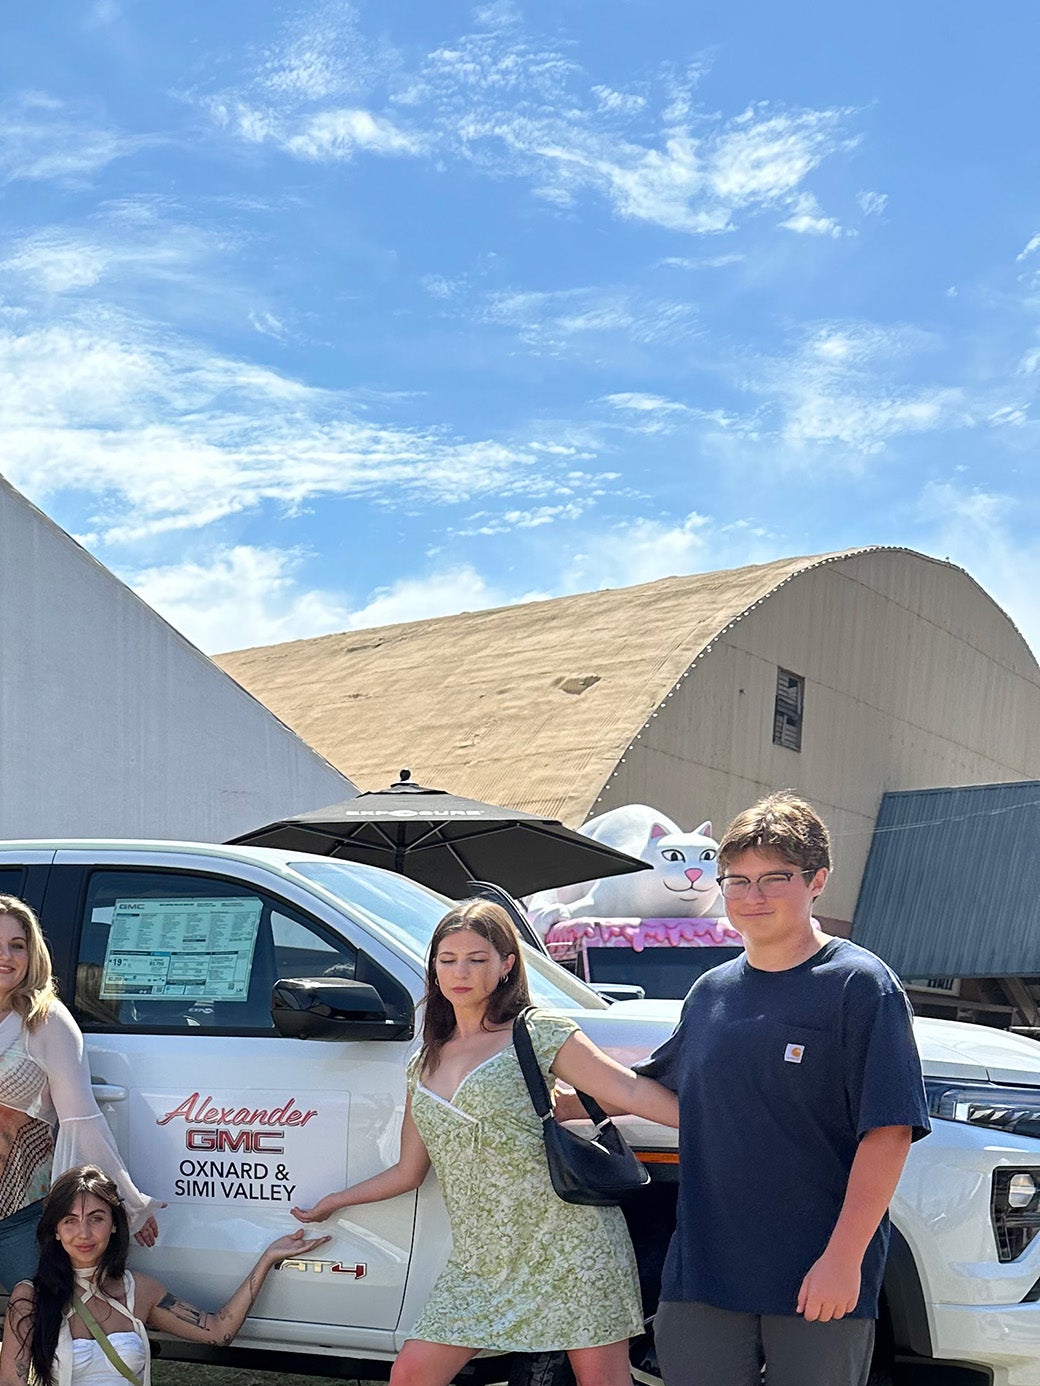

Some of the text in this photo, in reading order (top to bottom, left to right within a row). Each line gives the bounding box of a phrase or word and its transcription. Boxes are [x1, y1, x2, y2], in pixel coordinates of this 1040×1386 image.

[156, 1091, 318, 1127] Alexander
[186, 1128, 285, 1155] GMC
[179, 1159, 290, 1181] OXNARD &
[174, 1179, 297, 1202] SIMI VALLEY
[274, 1258, 367, 1280] AT4
